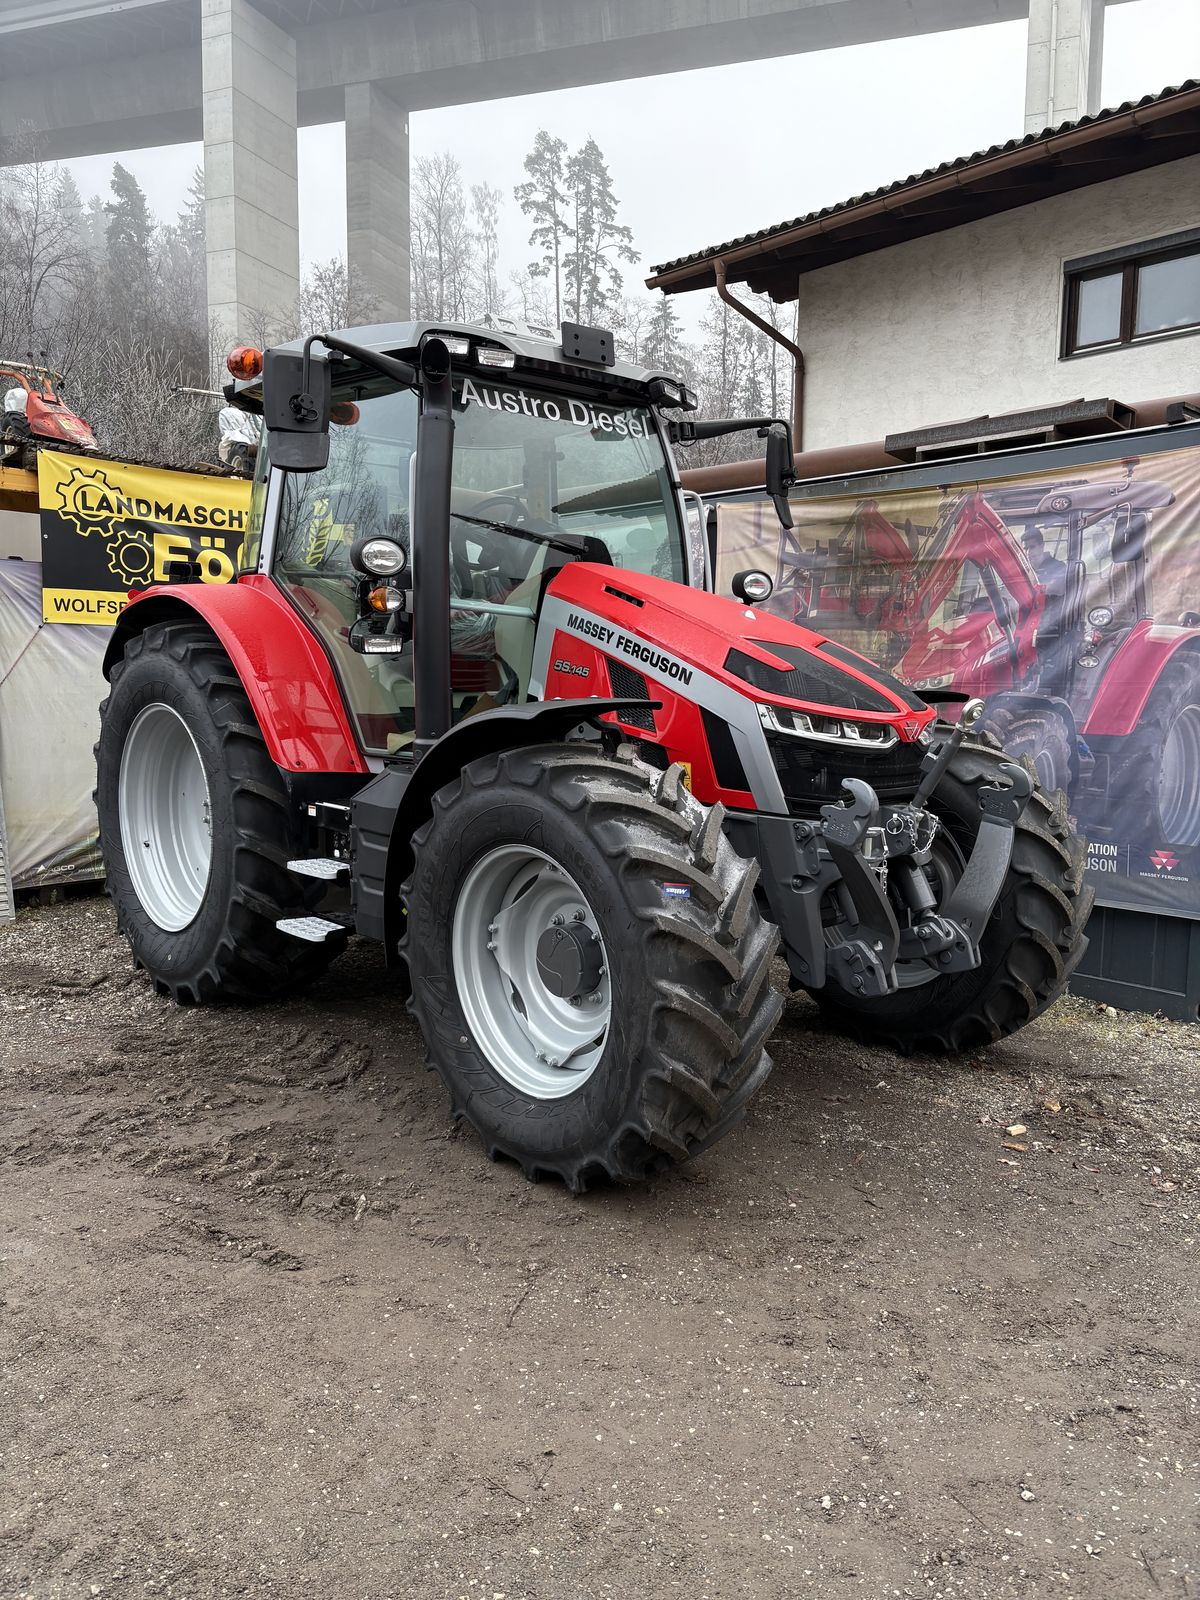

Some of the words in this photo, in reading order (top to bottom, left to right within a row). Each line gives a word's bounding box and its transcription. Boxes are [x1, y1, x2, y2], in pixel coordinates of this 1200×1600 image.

[461, 378, 561, 422] Austro
[568, 399, 650, 440] Diesel
[80, 489, 250, 529] LANDMASCH
[566, 613, 616, 644] MASSEY
[615, 634, 694, 686] FERGUSON
[1139, 871, 1160, 879] MASSEY
[1161, 874, 1189, 882] FERGUSON
